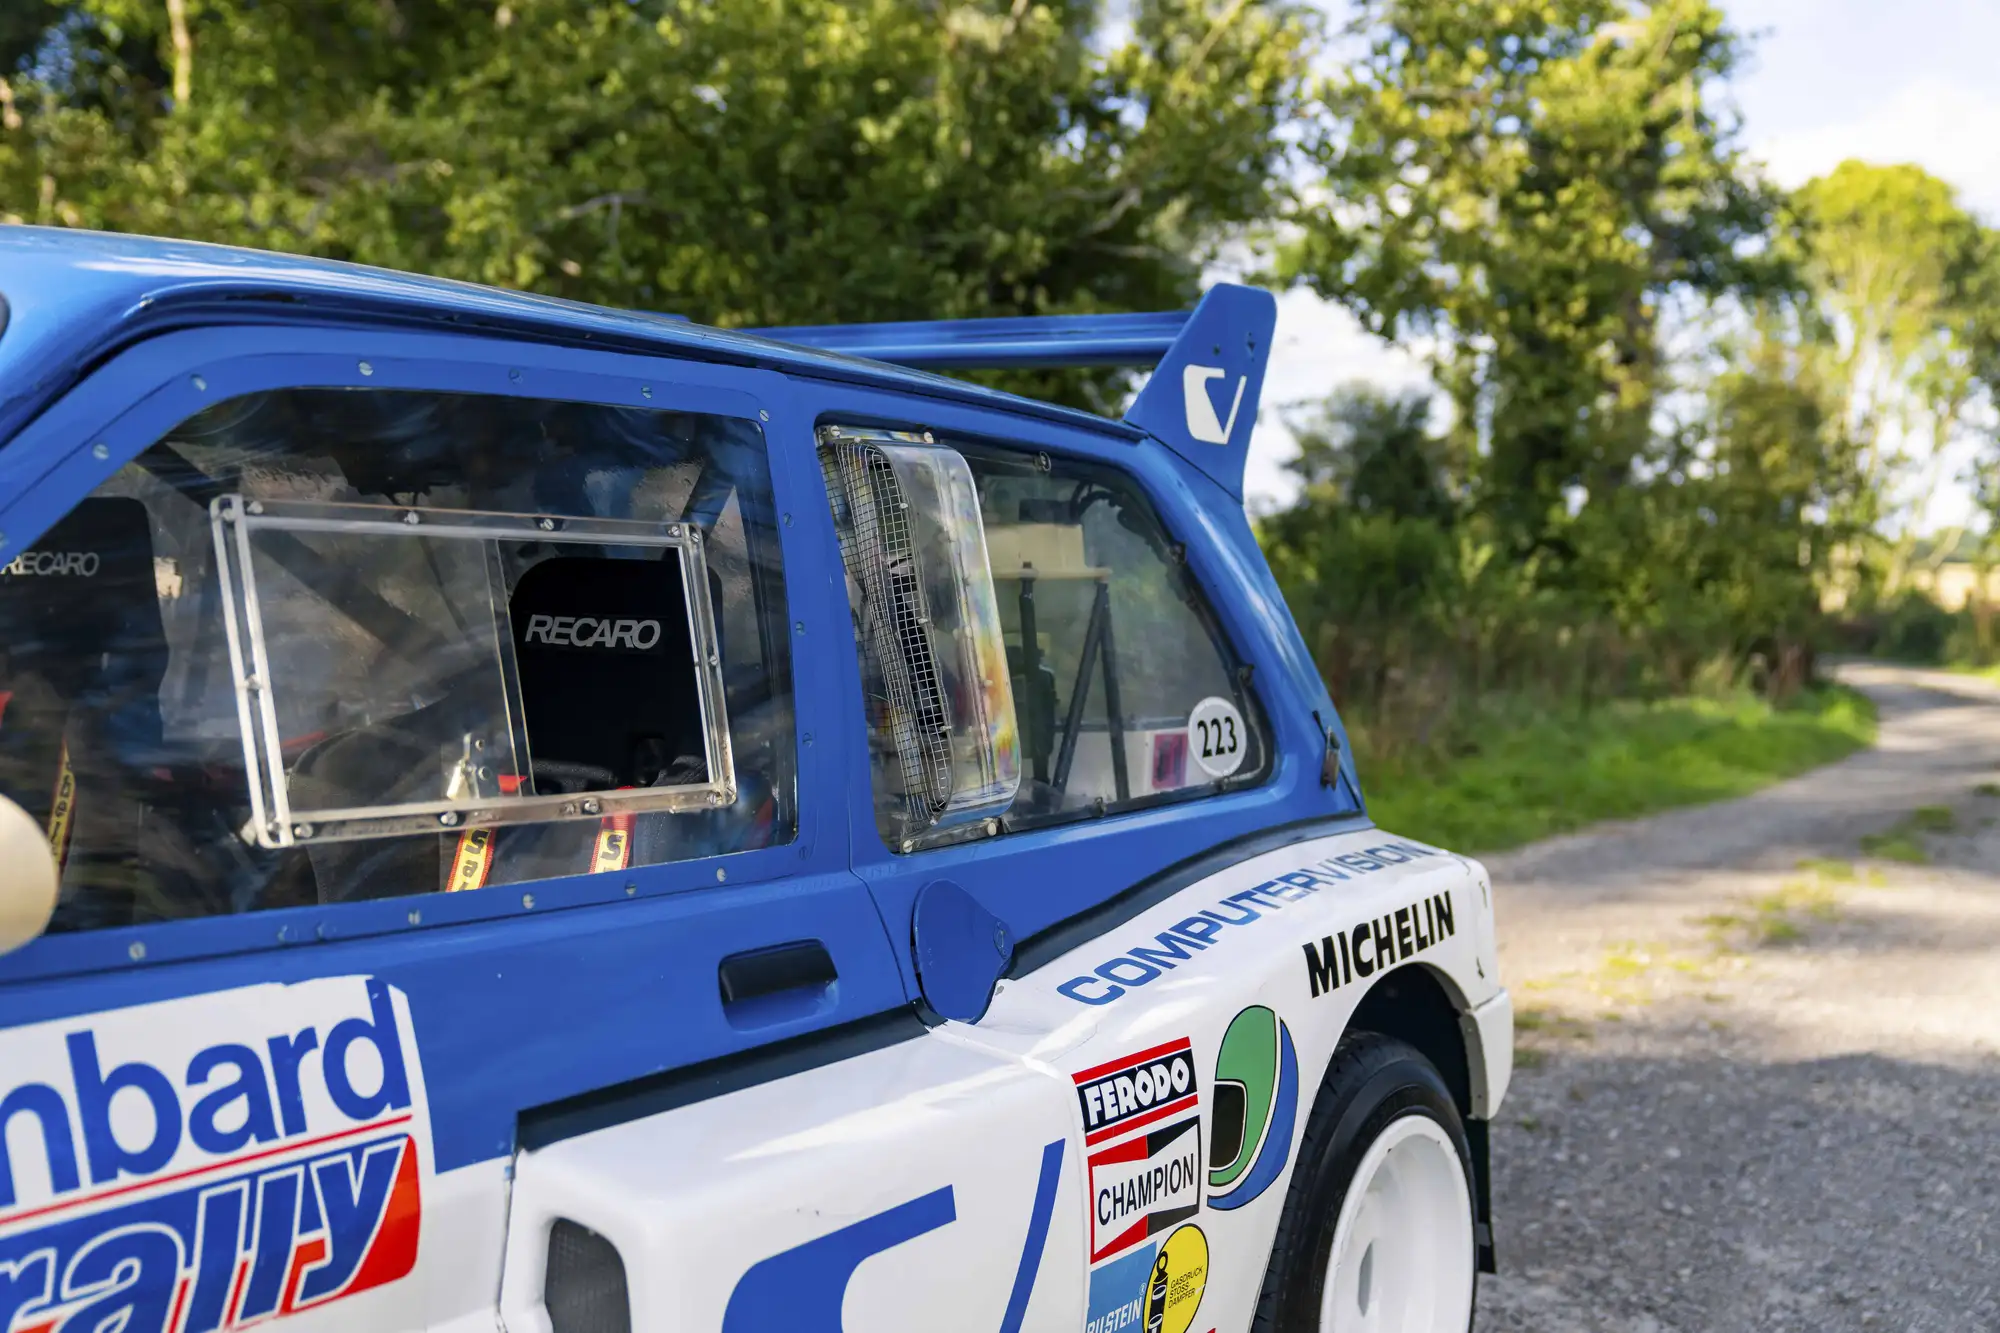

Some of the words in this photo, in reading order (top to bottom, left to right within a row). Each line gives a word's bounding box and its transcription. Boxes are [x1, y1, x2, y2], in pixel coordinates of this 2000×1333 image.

[525, 614, 661, 650] RECARO
[1197, 715, 1238, 758] 223
[1056, 841, 1436, 1006] COMPUTERVISION
[1302, 890, 1455, 998] MICHELIN
[1084, 1057, 1190, 1127] FERODO
[1098, 1153, 1194, 1226] CHAMPION
